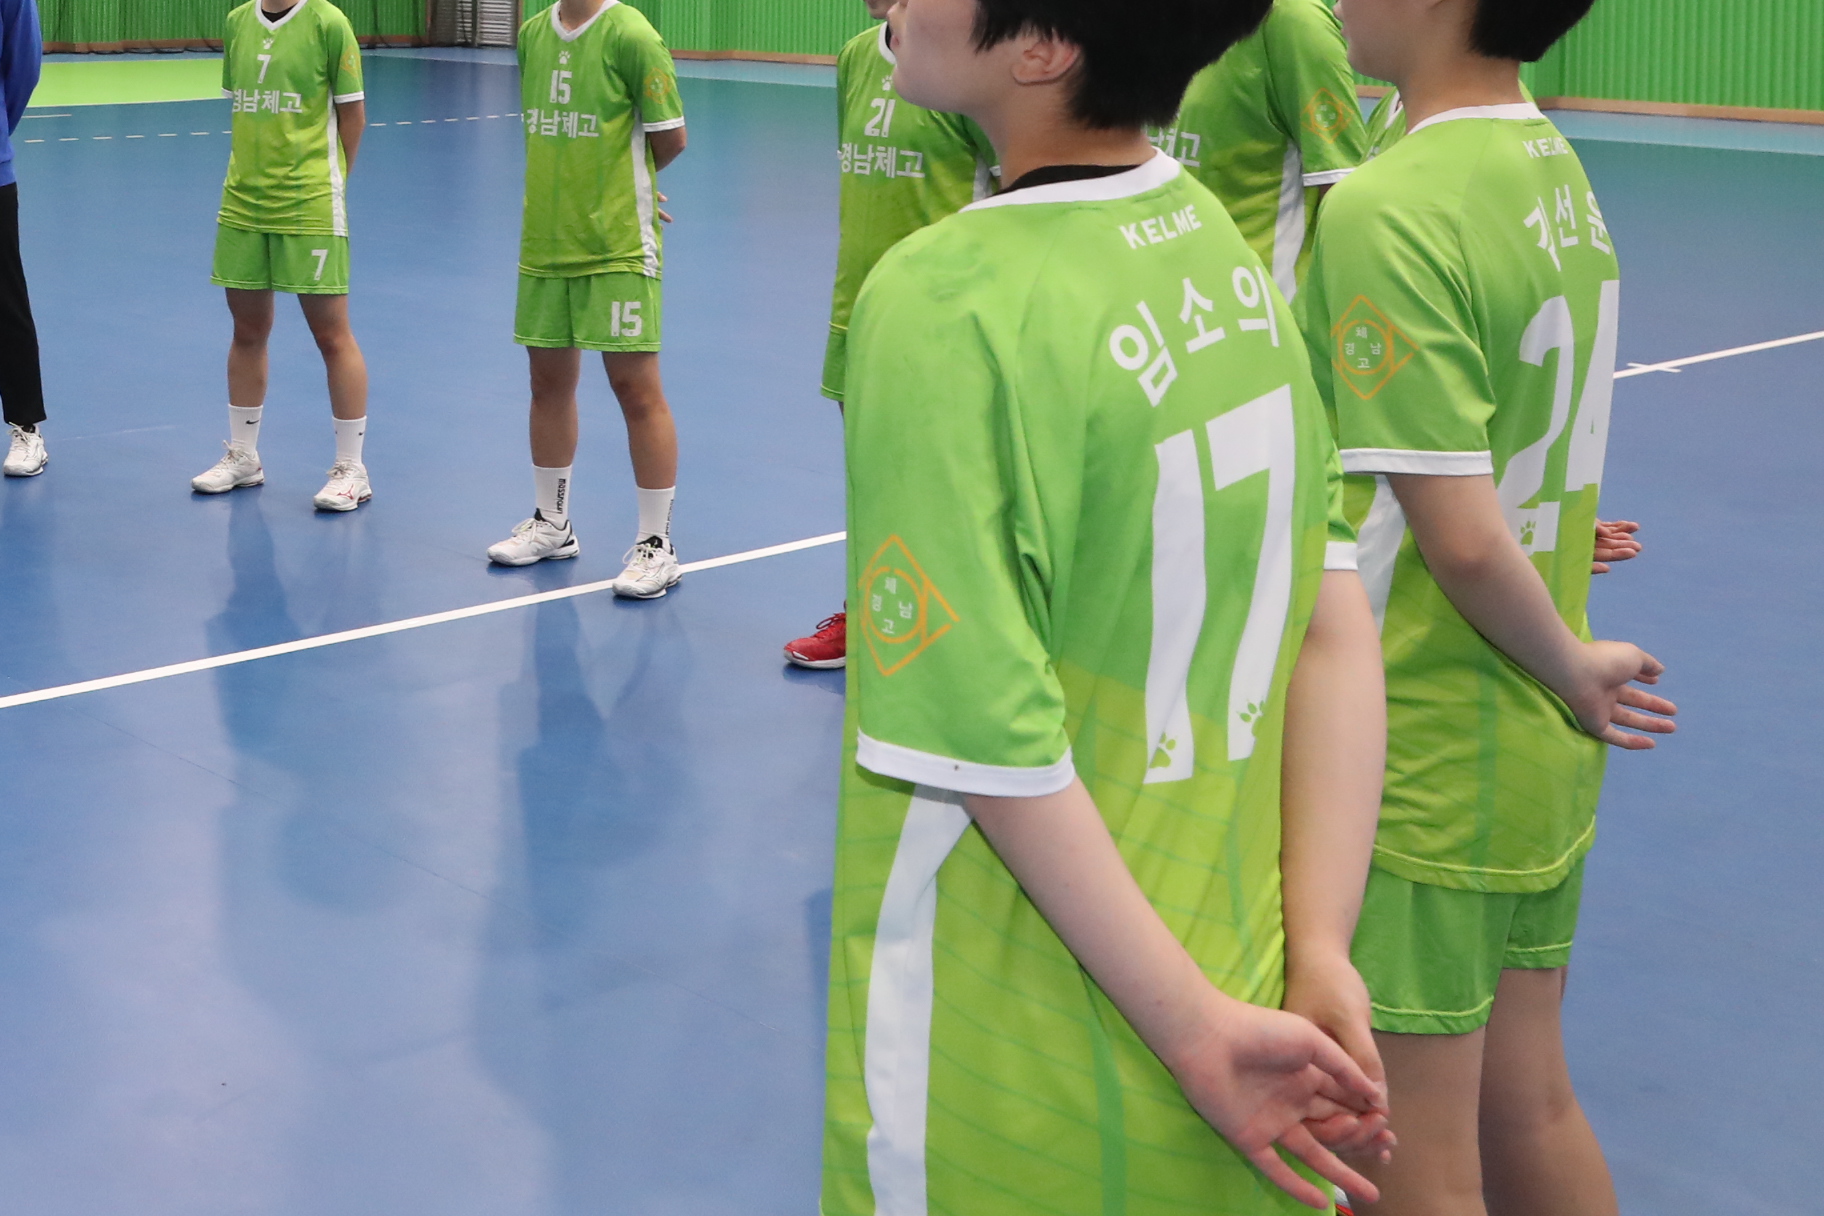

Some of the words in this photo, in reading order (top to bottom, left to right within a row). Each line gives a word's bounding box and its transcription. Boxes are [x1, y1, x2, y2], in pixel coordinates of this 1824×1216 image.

[257, 53, 272, 84] 7
[549, 69, 573, 105] 15
[527, 108, 600, 139] 경남체고
[864, 97, 897, 139] 21
[840, 142, 926, 179] 경남체고
[1119, 204, 1203, 250] KELME
[311, 249, 328, 281] 7
[610, 301, 642, 337] 15
[1495, 279, 1620, 557] 24
[1141, 383, 1296, 784] 17
